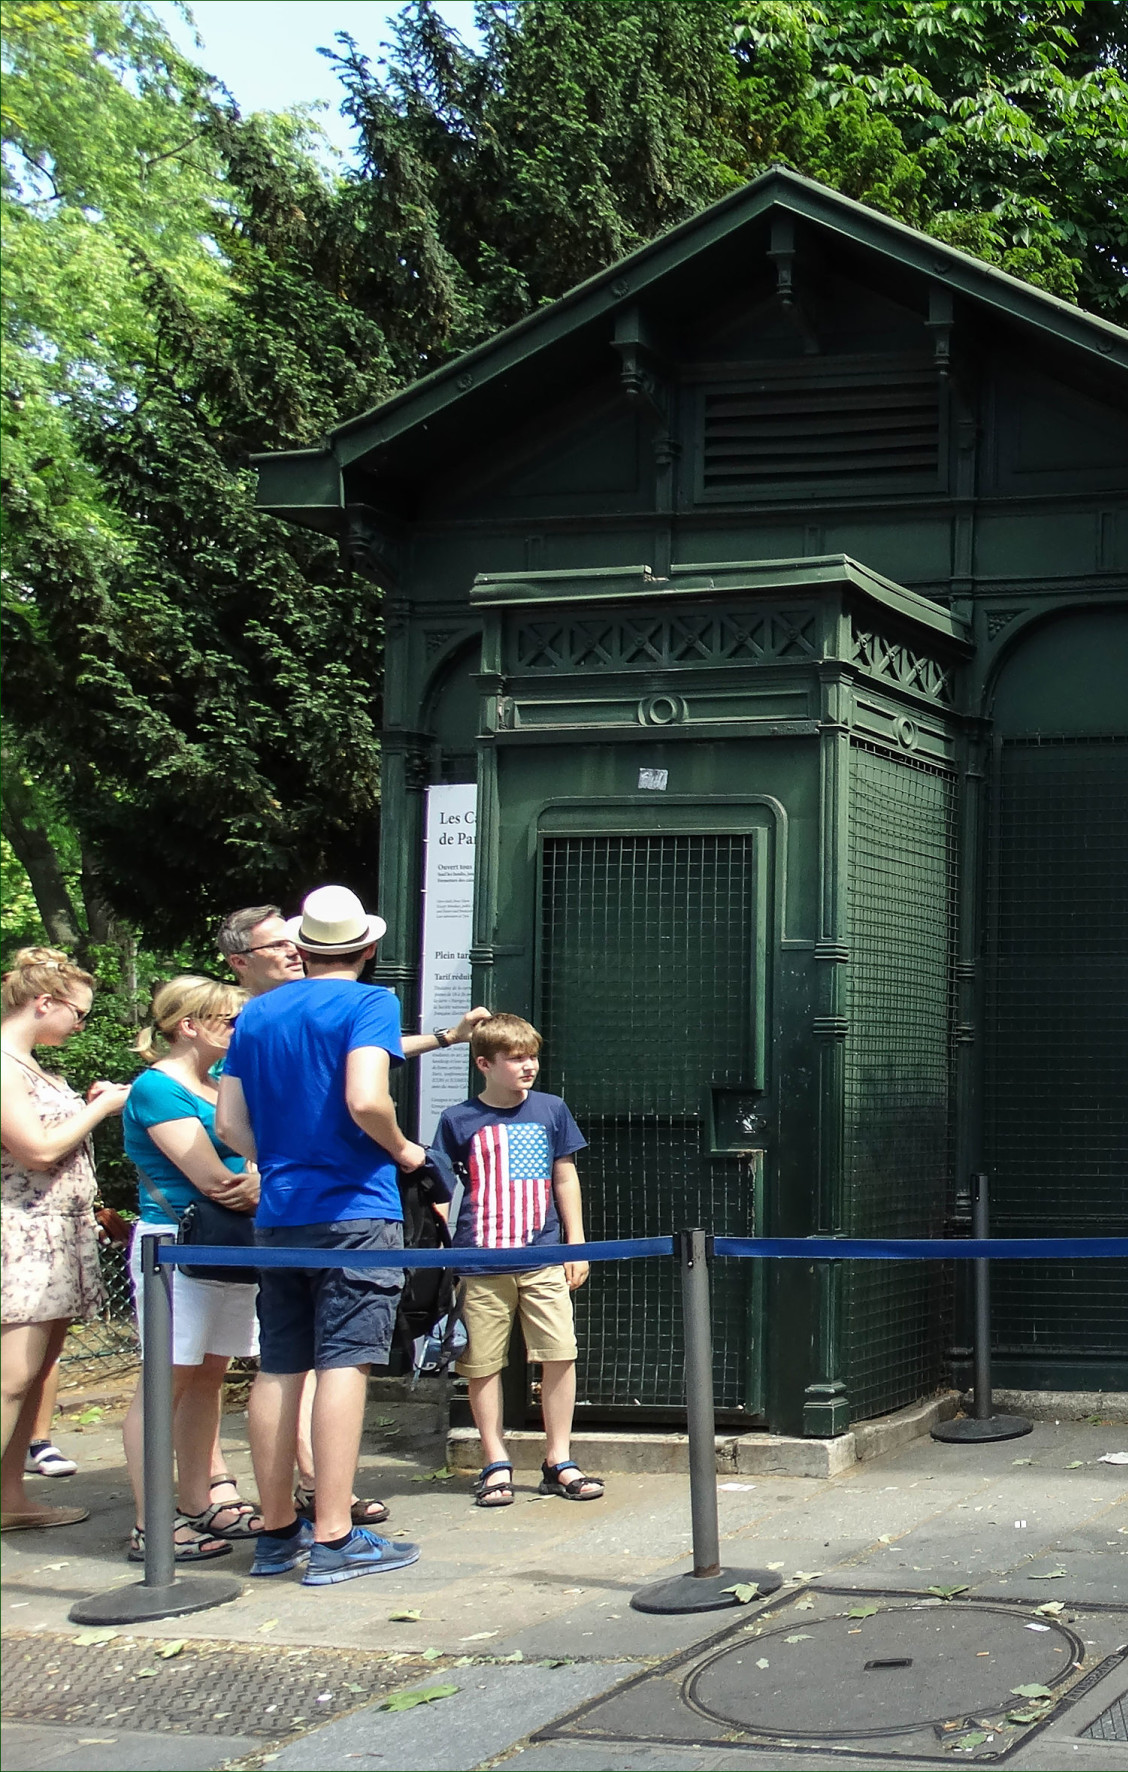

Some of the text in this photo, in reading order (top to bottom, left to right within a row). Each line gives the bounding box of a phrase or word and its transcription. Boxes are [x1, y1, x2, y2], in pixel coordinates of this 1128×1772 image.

[439, 811, 477, 824] Les C
[439, 832, 454, 845] de
[435, 951, 455, 959] Plein
